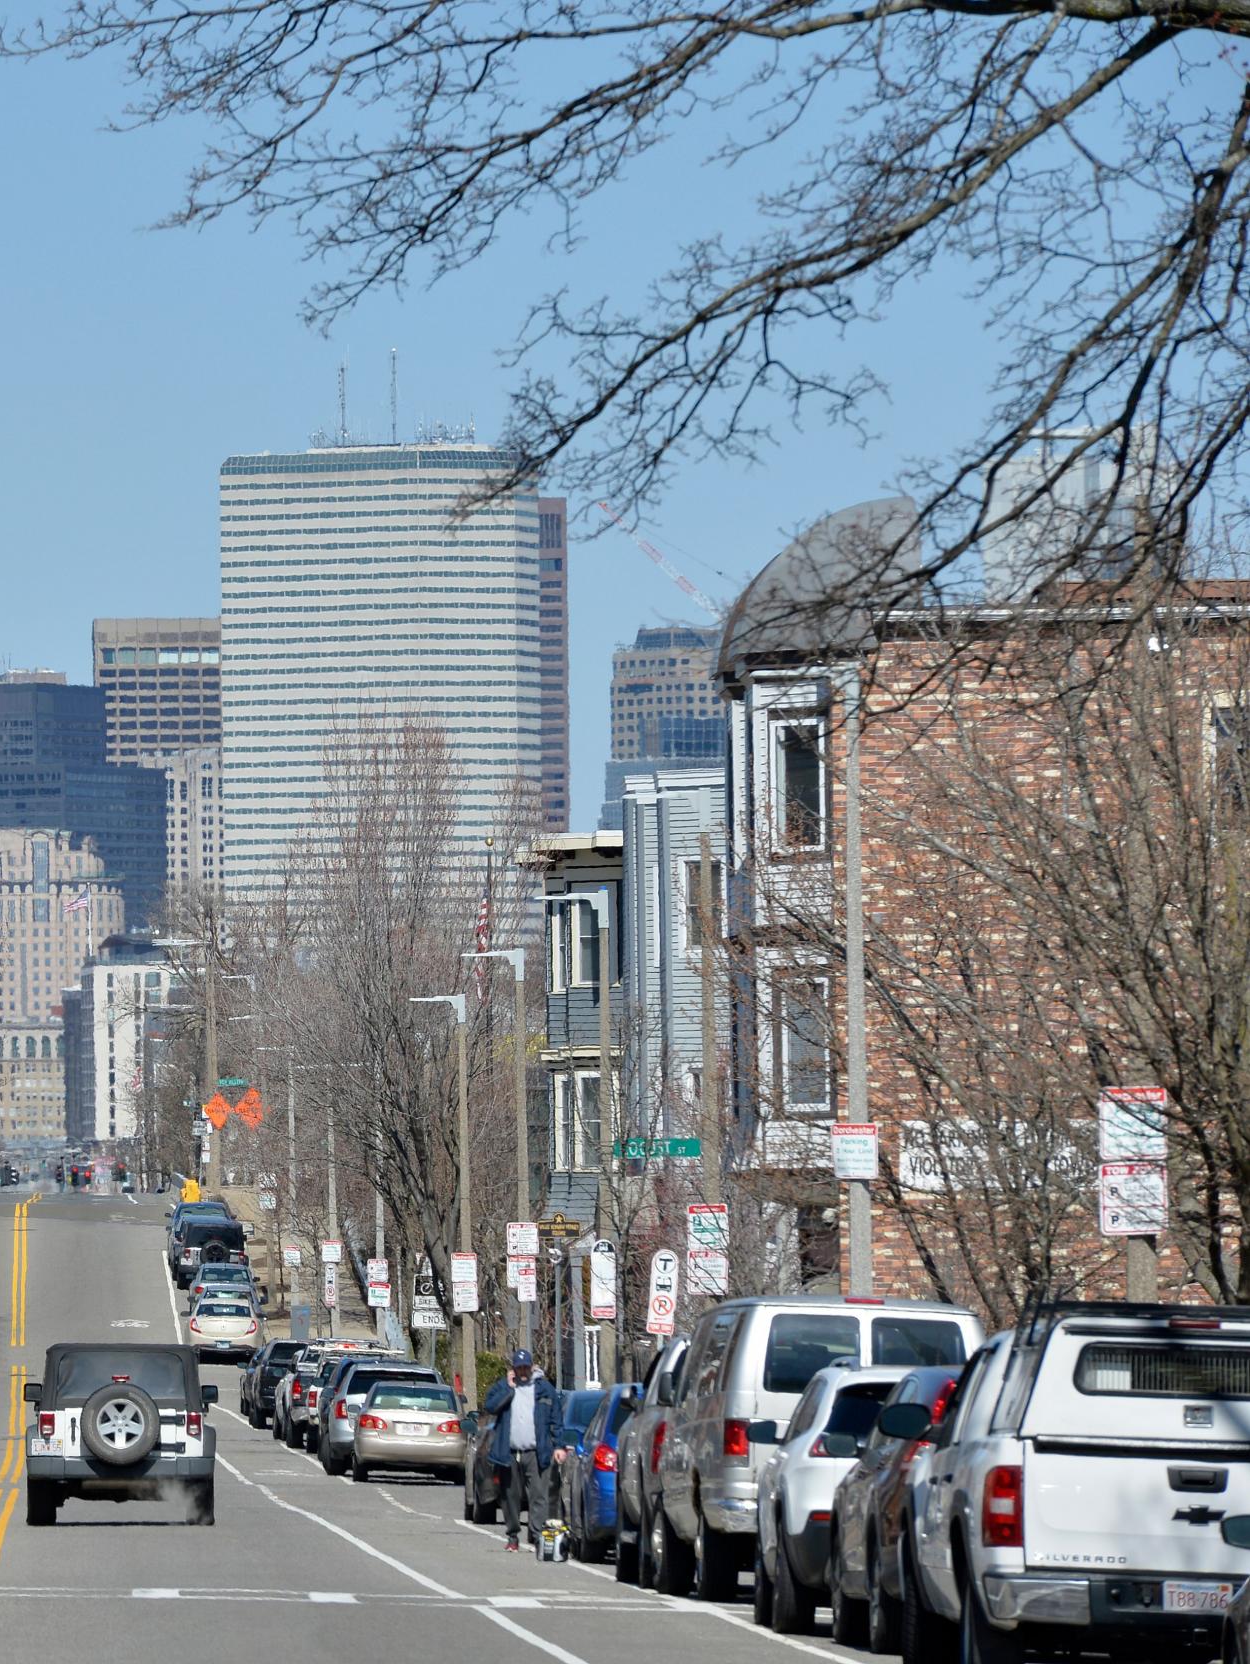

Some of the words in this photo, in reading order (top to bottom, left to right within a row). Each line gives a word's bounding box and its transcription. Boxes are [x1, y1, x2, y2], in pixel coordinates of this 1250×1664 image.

[621, 1141, 671, 1156] OCUST
[677, 1146, 687, 1154] ST
[1105, 1166, 1129, 1175] TOW
[422, 1315, 446, 1324] ENDS
